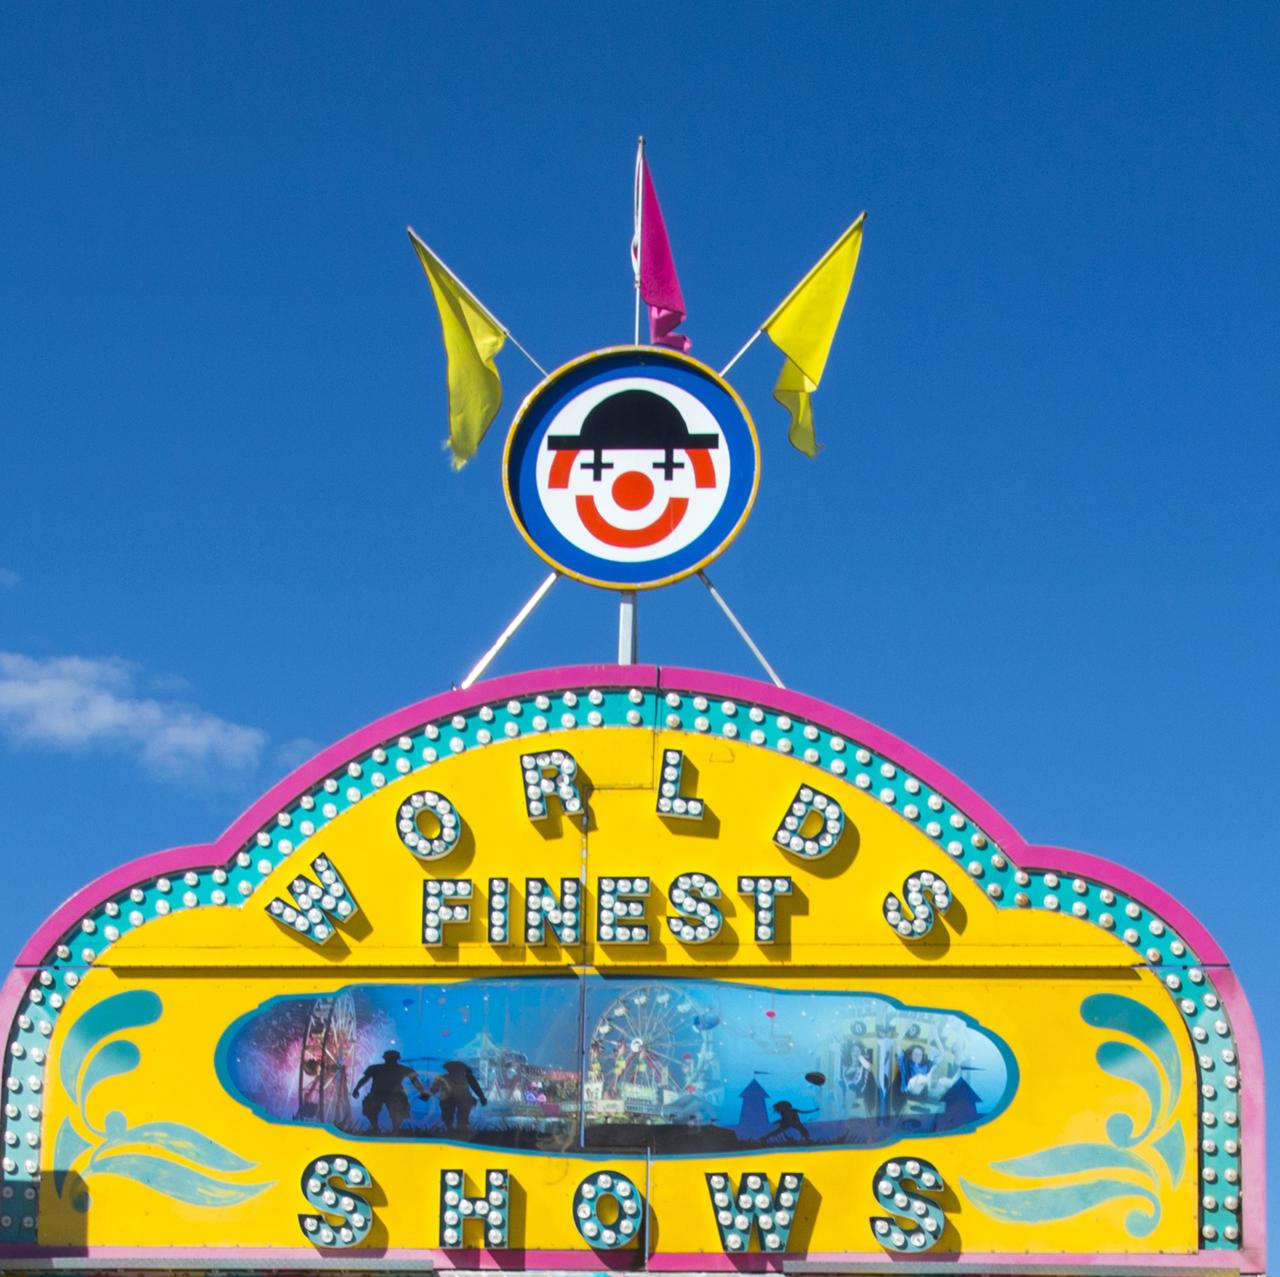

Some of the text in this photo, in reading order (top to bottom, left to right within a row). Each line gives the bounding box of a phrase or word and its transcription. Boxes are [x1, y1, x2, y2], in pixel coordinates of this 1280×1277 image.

[265, 746, 954, 948] WORLDS
[420, 870, 795, 948] FINEST
[296, 1153, 949, 1255] SHOWS
